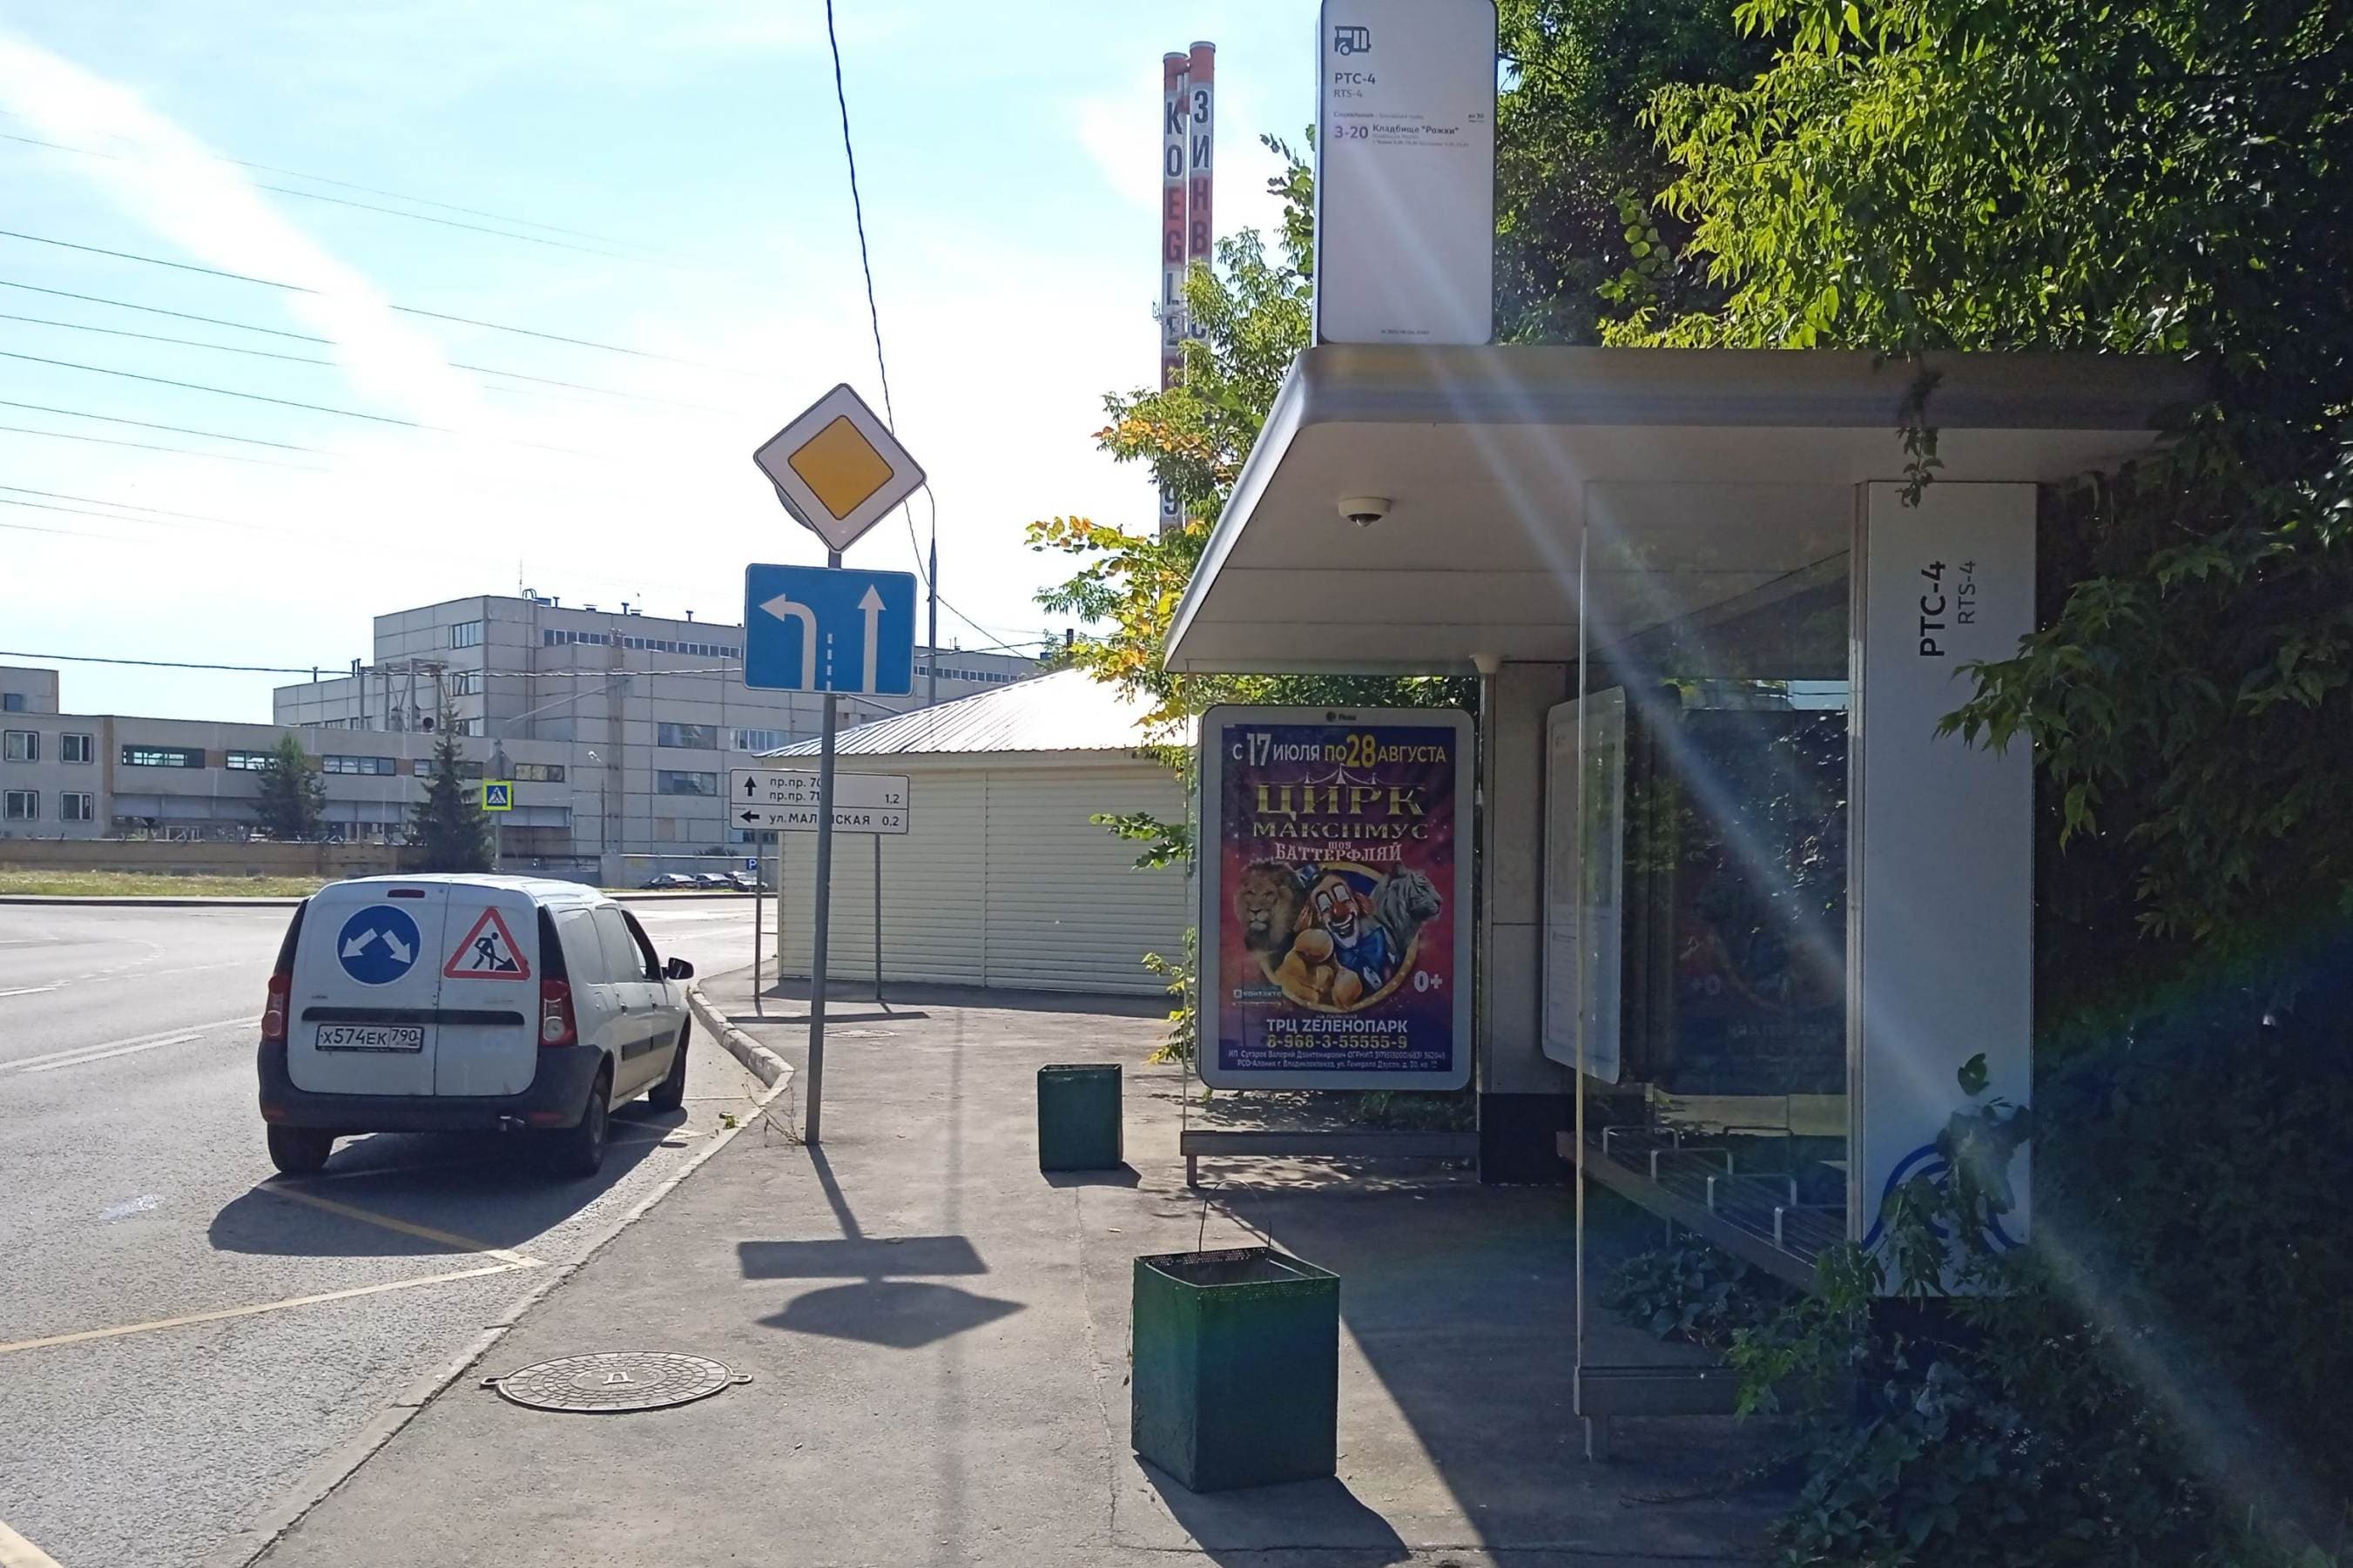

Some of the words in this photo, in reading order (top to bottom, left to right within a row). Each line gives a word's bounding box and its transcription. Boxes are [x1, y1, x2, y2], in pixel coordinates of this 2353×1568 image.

[1334, 72, 1375, 85] РТС-4
[1333, 89, 1363, 98] RTS-4
[1334, 125, 1369, 139] 3-20
[1372, 124, 1419, 134] Кладбище
[1958, 561, 1976, 624] RTS-4
[1919, 561, 1945, 656] РТС-4
[1232, 744, 1243, 760] С
[1246, 732, 1271, 766] 17
[1273, 744, 1320, 762] ИЮЛЯ
[1324, 745, 1346, 762] ПО
[1346, 734, 1376, 768] 28
[1378, 745, 1446, 763] АВГУСТА
[770, 777, 806, 788] пр.пр.
[770, 791, 806, 802] пр.пр.
[1257, 784, 1427, 821] ЦИРК
[1253, 822, 1428, 839] МАКСИМУС
[1274, 842, 1402, 861] БАТТЕРФЛЯЙ
[749, 859, 758, 869] P
[1413, 971, 1442, 993] 0+
[1266, 1019, 1298, 1033] ТРЦ
[1302, 1020, 1408, 1033] ZЕЛЕНОПАРК
[323, 1028, 388, 1045] Х574ЕК
[392, 1029, 417, 1042] 790
[1267, 1034, 1408, 1048] 8-968-3-55555-9
